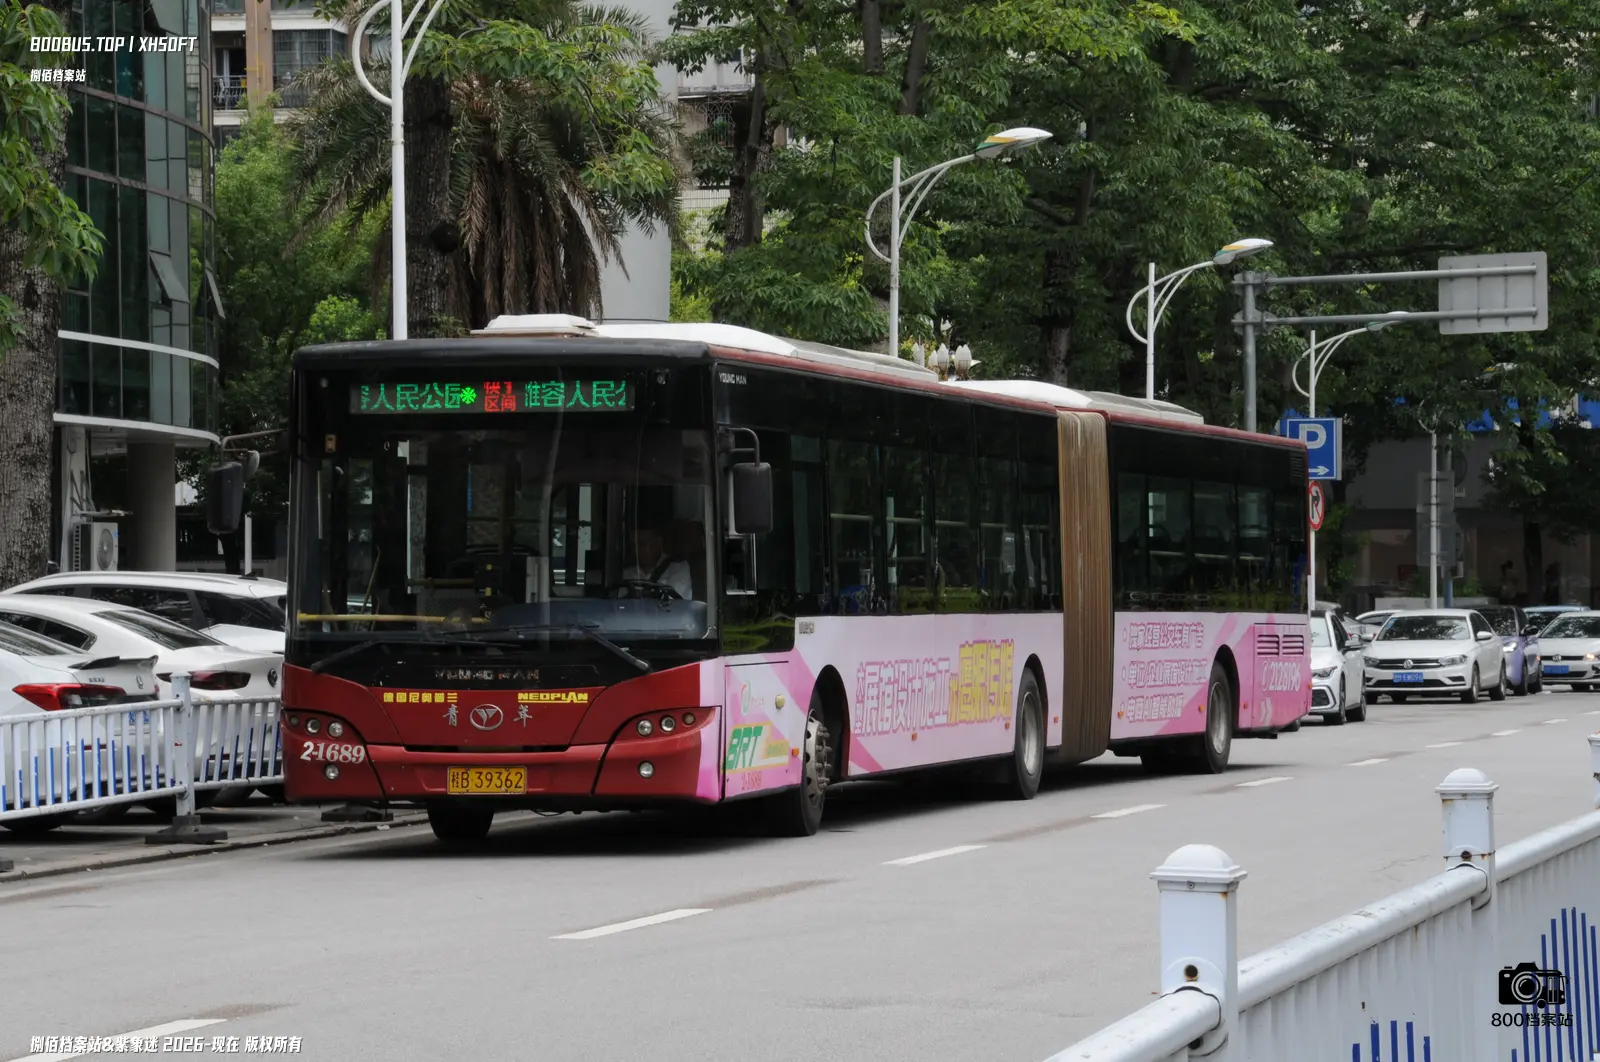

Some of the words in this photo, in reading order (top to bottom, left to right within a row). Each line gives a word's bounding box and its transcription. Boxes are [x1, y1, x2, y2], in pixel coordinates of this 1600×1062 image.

[735, 374, 747, 385] MAN
[484, 394, 516, 412] 区间
[1299, 424, 1327, 449] P
[517, 692, 588, 704] NEOPLAN
[727, 726, 763, 770] BRT
